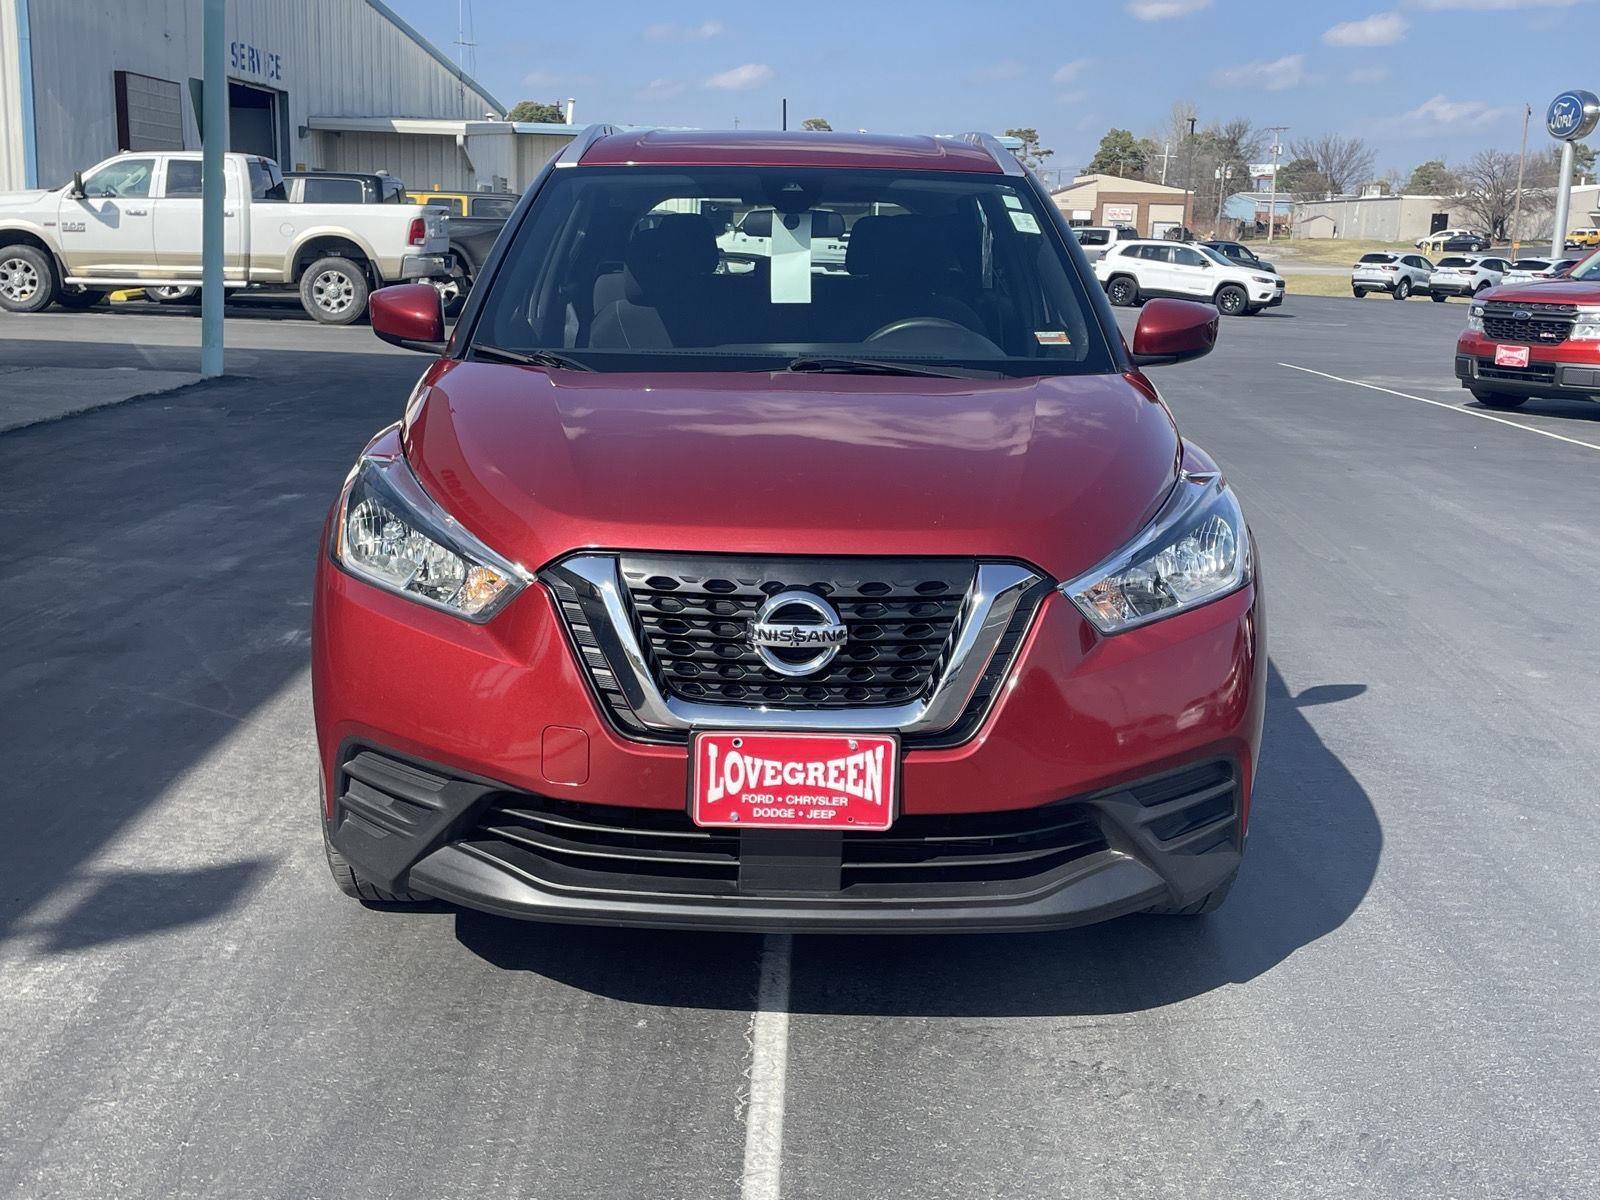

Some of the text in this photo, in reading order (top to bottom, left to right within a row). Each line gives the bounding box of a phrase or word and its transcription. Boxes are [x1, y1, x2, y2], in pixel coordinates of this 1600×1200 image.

[1551, 102, 1576, 129] Ford
[757, 629, 836, 642] NISSAN
[707, 742, 885, 806] LOVEGREEN
[741, 794, 848, 807] FORD CHRYSLER
[753, 808, 837, 820] DODGE JEEP
